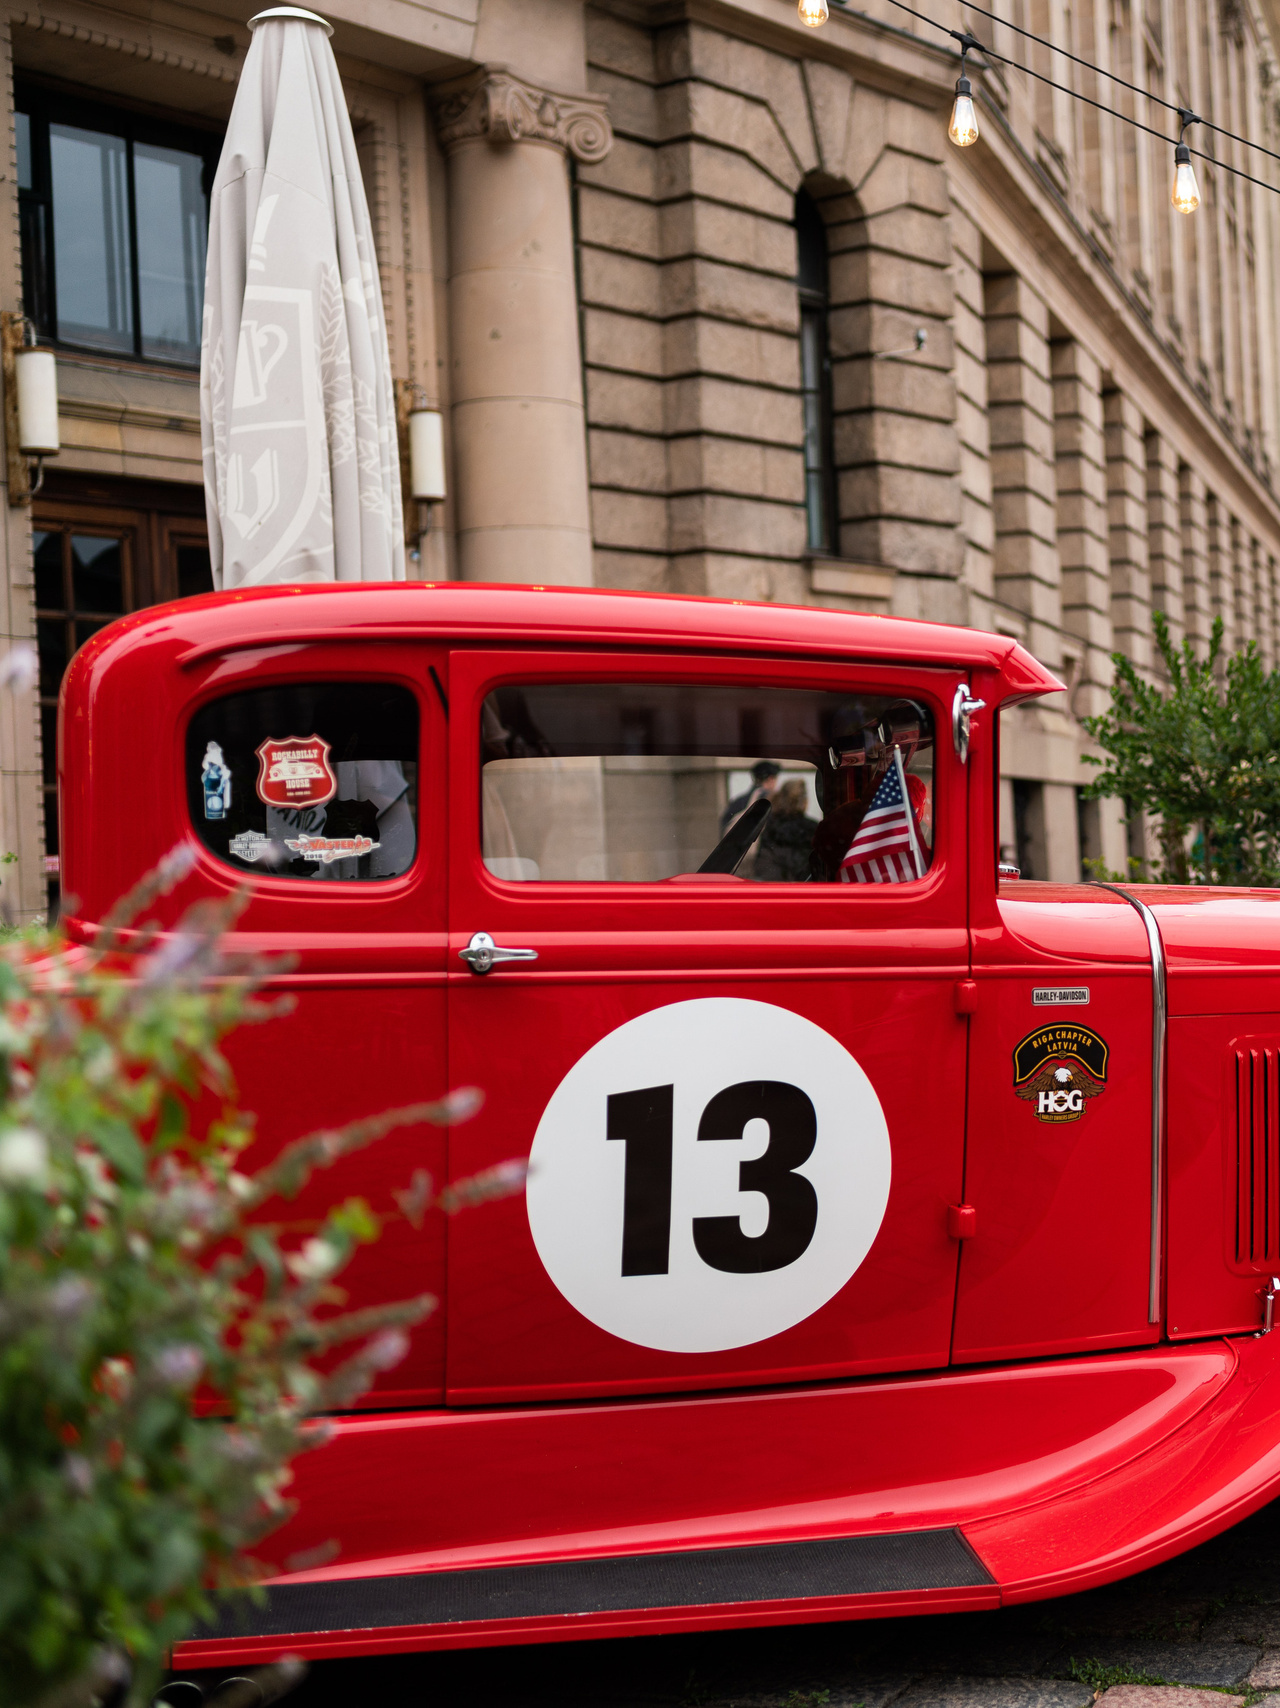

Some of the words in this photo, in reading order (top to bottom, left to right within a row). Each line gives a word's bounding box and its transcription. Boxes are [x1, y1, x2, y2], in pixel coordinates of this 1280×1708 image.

[272, 749, 318, 761] ROCKABILLY
[286, 779, 310, 789] HOUSE
[1035, 991, 1086, 1001] HARLEY-DAVIDSON
[1032, 1033, 1053, 1048] RIGA
[1055, 1031, 1092, 1046] CHAPTER
[1047, 1041, 1077, 1053] LATVIA
[1038, 1090, 1083, 1113] HOG
[606, 1080, 818, 1277] 13
